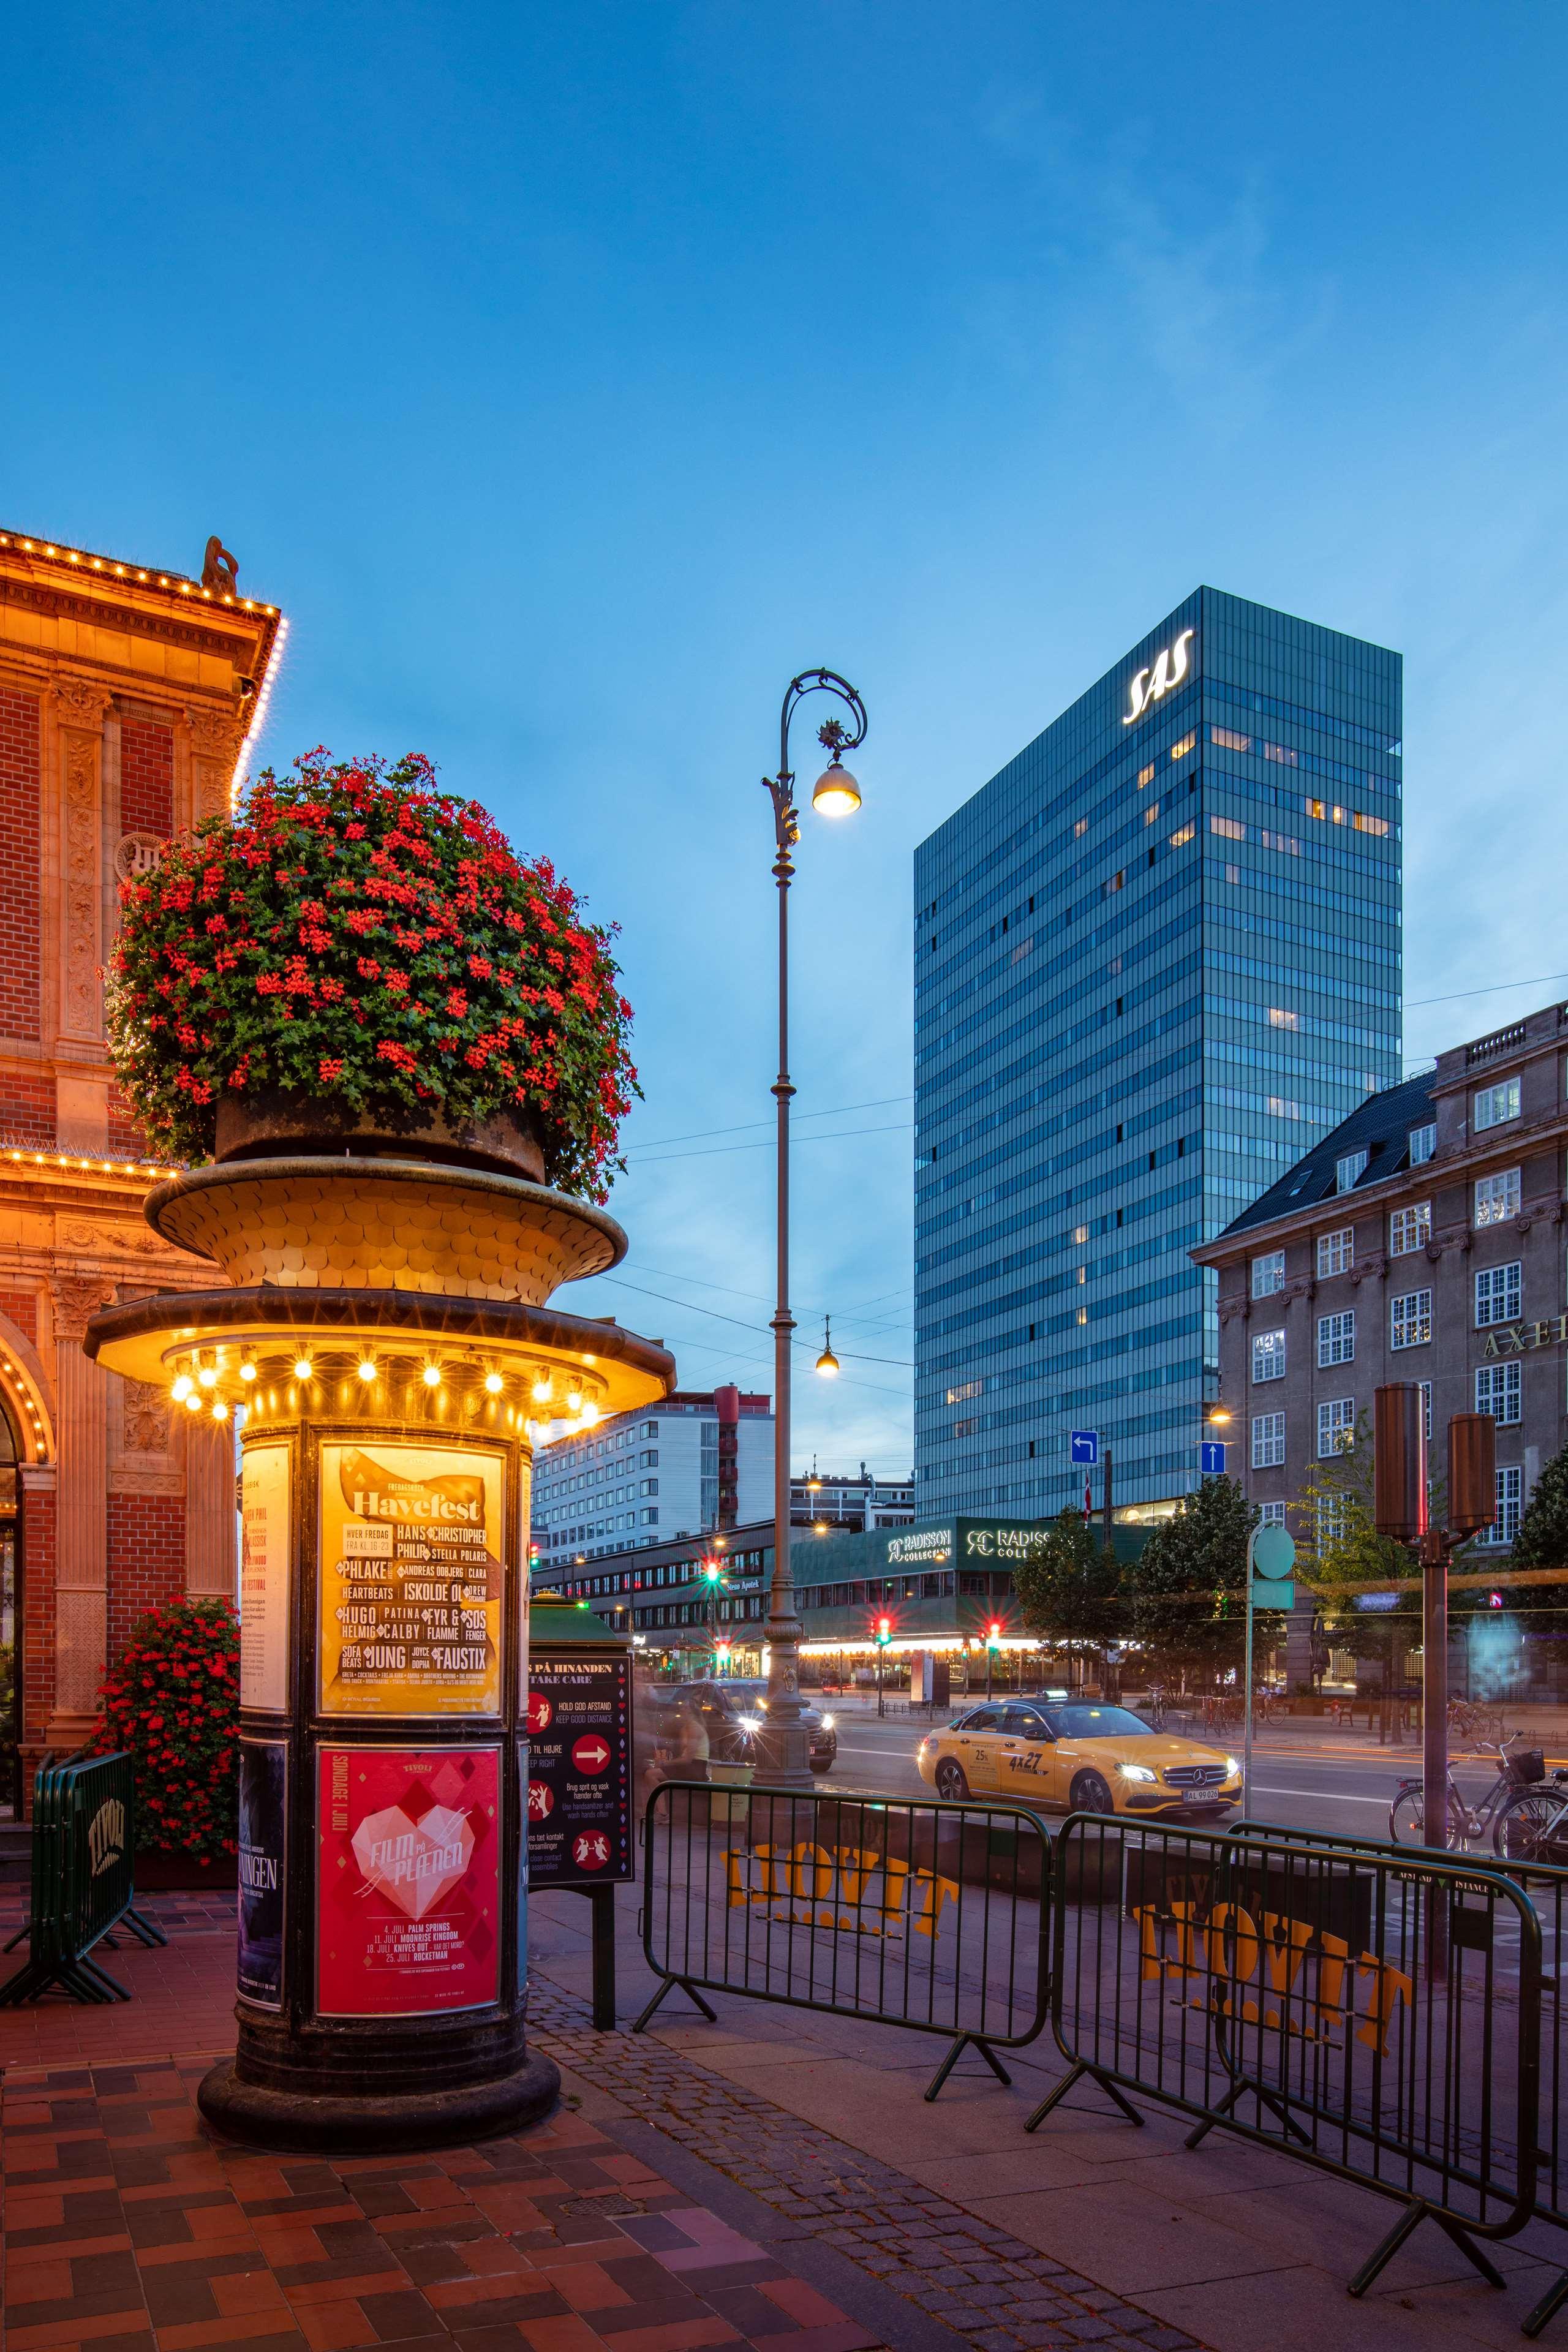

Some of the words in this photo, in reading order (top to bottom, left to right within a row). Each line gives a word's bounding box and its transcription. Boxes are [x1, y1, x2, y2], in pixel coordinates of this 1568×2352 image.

[1123, 629, 1193, 724] SAS
[353, 1491, 480, 1521] Havefest
[347, 1529, 363, 1539] HVER
[365, 1529, 388, 1539] FREDAG
[398, 1525, 426, 1541] HANS
[432, 1526, 488, 1544] CHRISTOPHER
[998, 1530, 1049, 1547] RADIS
[347, 1540, 359, 1551] FRA
[904, 1529, 951, 1551] RADISSON
[398, 1543, 425, 1559] PHILIP
[432, 1548, 458, 1561] STELLA
[461, 1550, 487, 1562] POLARIS
[343, 1561, 386, 1580] PHLAKE
[405, 1565, 434, 1577] ANDREAS
[436, 1566, 464, 1578] ODBJERG
[469, 1568, 486, 1579] CLARA
[247, 1578, 266, 1591] FESTIVAL
[469, 1586, 486, 1596] DREW
[741, 1579, 760, 1591] Apotek
[342, 1587, 393, 1600] HEARTBEATS
[404, 1583, 448, 1602] ISKOLDE
[451, 1583, 463, 1602] ØL
[342, 1607, 376, 1624] HUGO
[384, 1607, 420, 1619] PATINA
[428, 1608, 447, 1626] FYR
[451, 1608, 459, 1626] &
[467, 1610, 486, 1629] SØS
[342, 1625, 375, 1639] HELMIG
[384, 1624, 420, 1640] CALBY
[427, 1627, 459, 1640] FLAMME
[466, 1630, 486, 1642] FENGER
[342, 1645, 361, 1657] SOFA
[366, 1646, 405, 1669] JUNG
[412, 1646, 430, 1657] JOYCE
[342, 1657, 361, 1668] BEATS
[412, 1659, 430, 1670] DOPHA
[436, 1647, 486, 1670] FAUSTIX
[535, 1662, 551, 1673] PÅ
[554, 1664, 612, 1673] HINANDEN
[559, 1702, 573, 1711] HOLD
[575, 1702, 586, 1711] GOD
[588, 1702, 611, 1711] AFSTAND
[556, 1715, 569, 1724] KEEP
[571, 1715, 586, 1724] GOOD
[587, 1714, 612, 1724] DISTANCE
[543, 1745, 562, 1754] HØJRE
[539, 1758, 556, 1768] RIGHT
[567, 1783, 578, 1792] Brug
[579, 1783, 590, 1792] sprit
[332, 1809, 349, 1831] JULI
[371, 1833, 415, 1868] FILM
[416, 1840, 426, 1854] PÅ
[395, 1842, 463, 1886] PLÆNEN
[239, 1852, 277, 1890] NINGEN
[1455, 1880, 1488, 1893] ISTANCE
[384, 1925, 390, 1934] 4.
[391, 1925, 404, 1934] JULI
[408, 1924, 424, 1933] PALM
[426, 1922, 450, 1932] SPRINGS
[384, 1935, 396, 1943] JULI
[400, 1934, 431, 1943] MOONRISE
[432, 1931, 458, 1942] KINGDOM
[367, 1944, 375, 1953] 18.
[377, 1944, 390, 1953] JULI
[394, 1943, 415, 1953] KNIVES
[417, 1942, 428, 1952] OUT
[386, 1953, 396, 1962] 25.
[397, 1953, 410, 1962] JULI
[413, 1950, 448, 1961] ROCKETMAN
